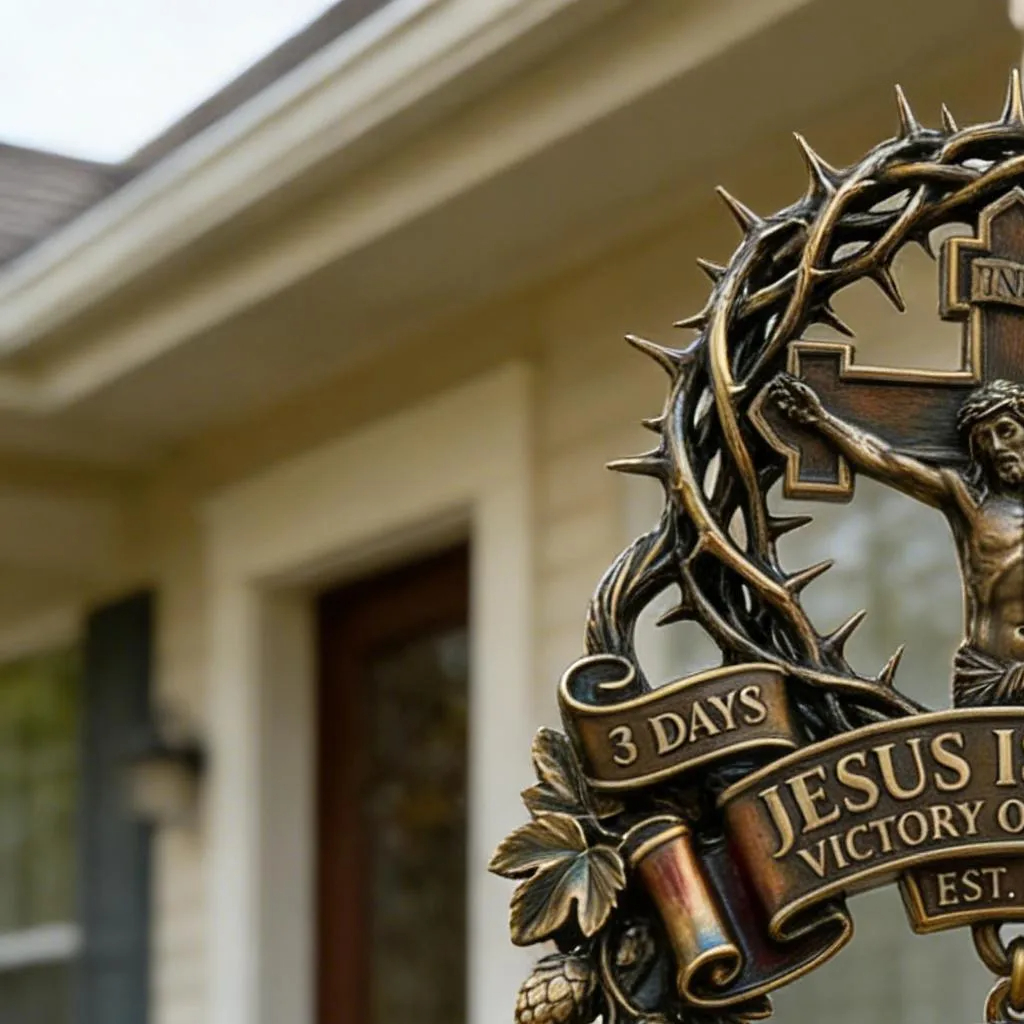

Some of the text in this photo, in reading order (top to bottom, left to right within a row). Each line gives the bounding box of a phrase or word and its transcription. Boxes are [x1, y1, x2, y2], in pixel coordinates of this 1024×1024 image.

[608, 685, 767, 767] 3 DAYS
[759, 732, 972, 859] JESUS
[799, 802, 984, 878] VICTORY
[937, 867, 1017, 906] EST.
